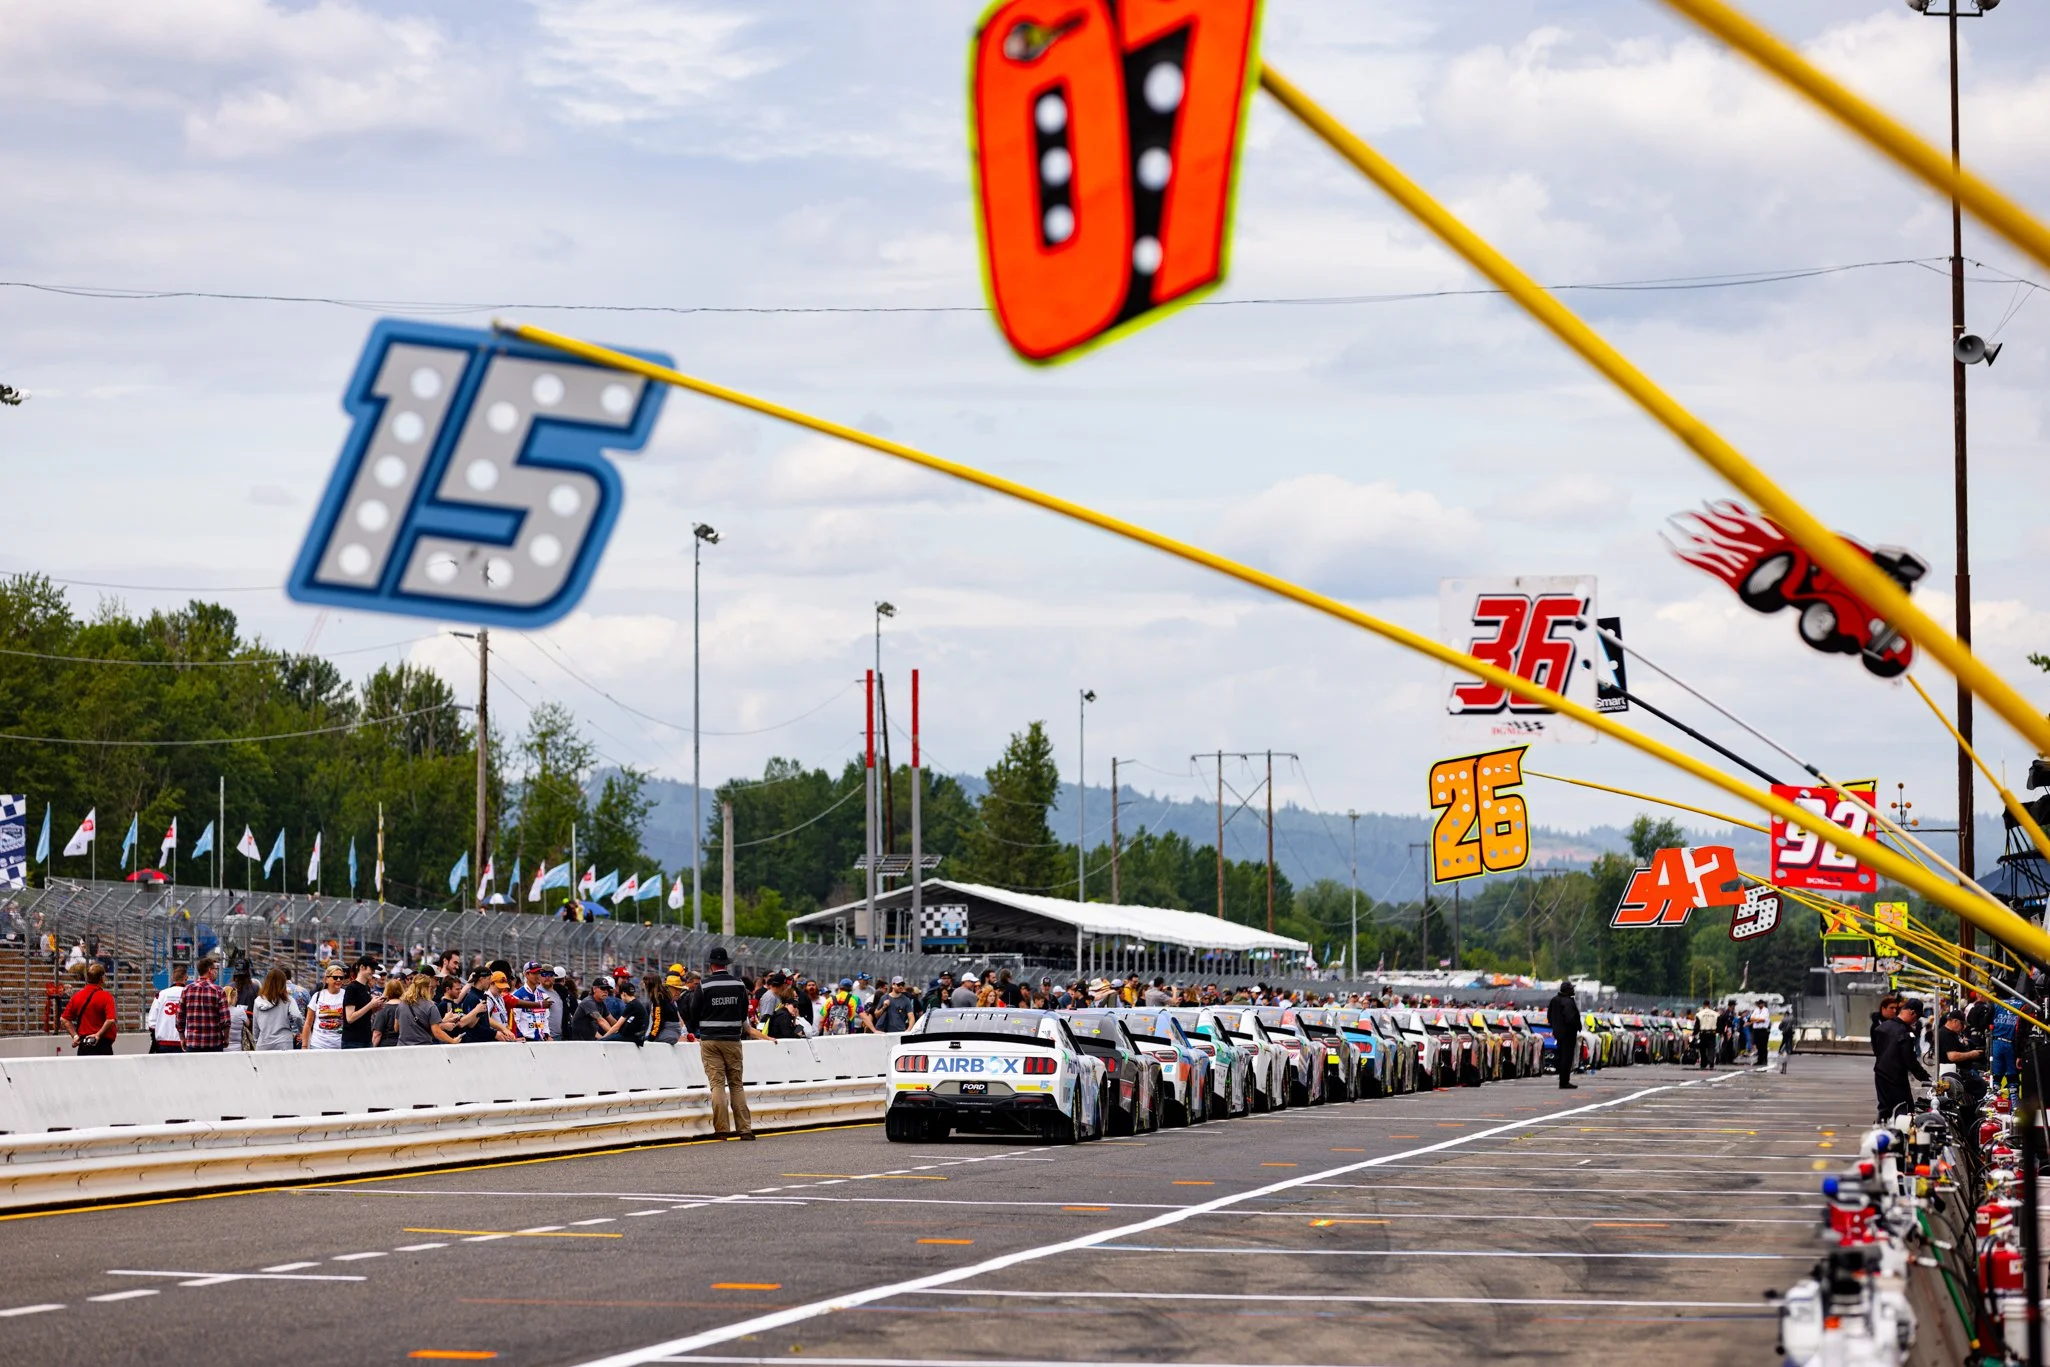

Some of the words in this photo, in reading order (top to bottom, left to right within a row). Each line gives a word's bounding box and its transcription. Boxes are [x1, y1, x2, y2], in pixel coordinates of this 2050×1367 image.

[297, 328, 660, 618] 15
[1449, 593, 1589, 714] 36
[1430, 746, 1531, 882] 26
[711, 996, 738, 1006] SECURITY
[932, 1056, 1019, 1074] AIRBOX
[1040, 1080, 1050, 1089] 15
